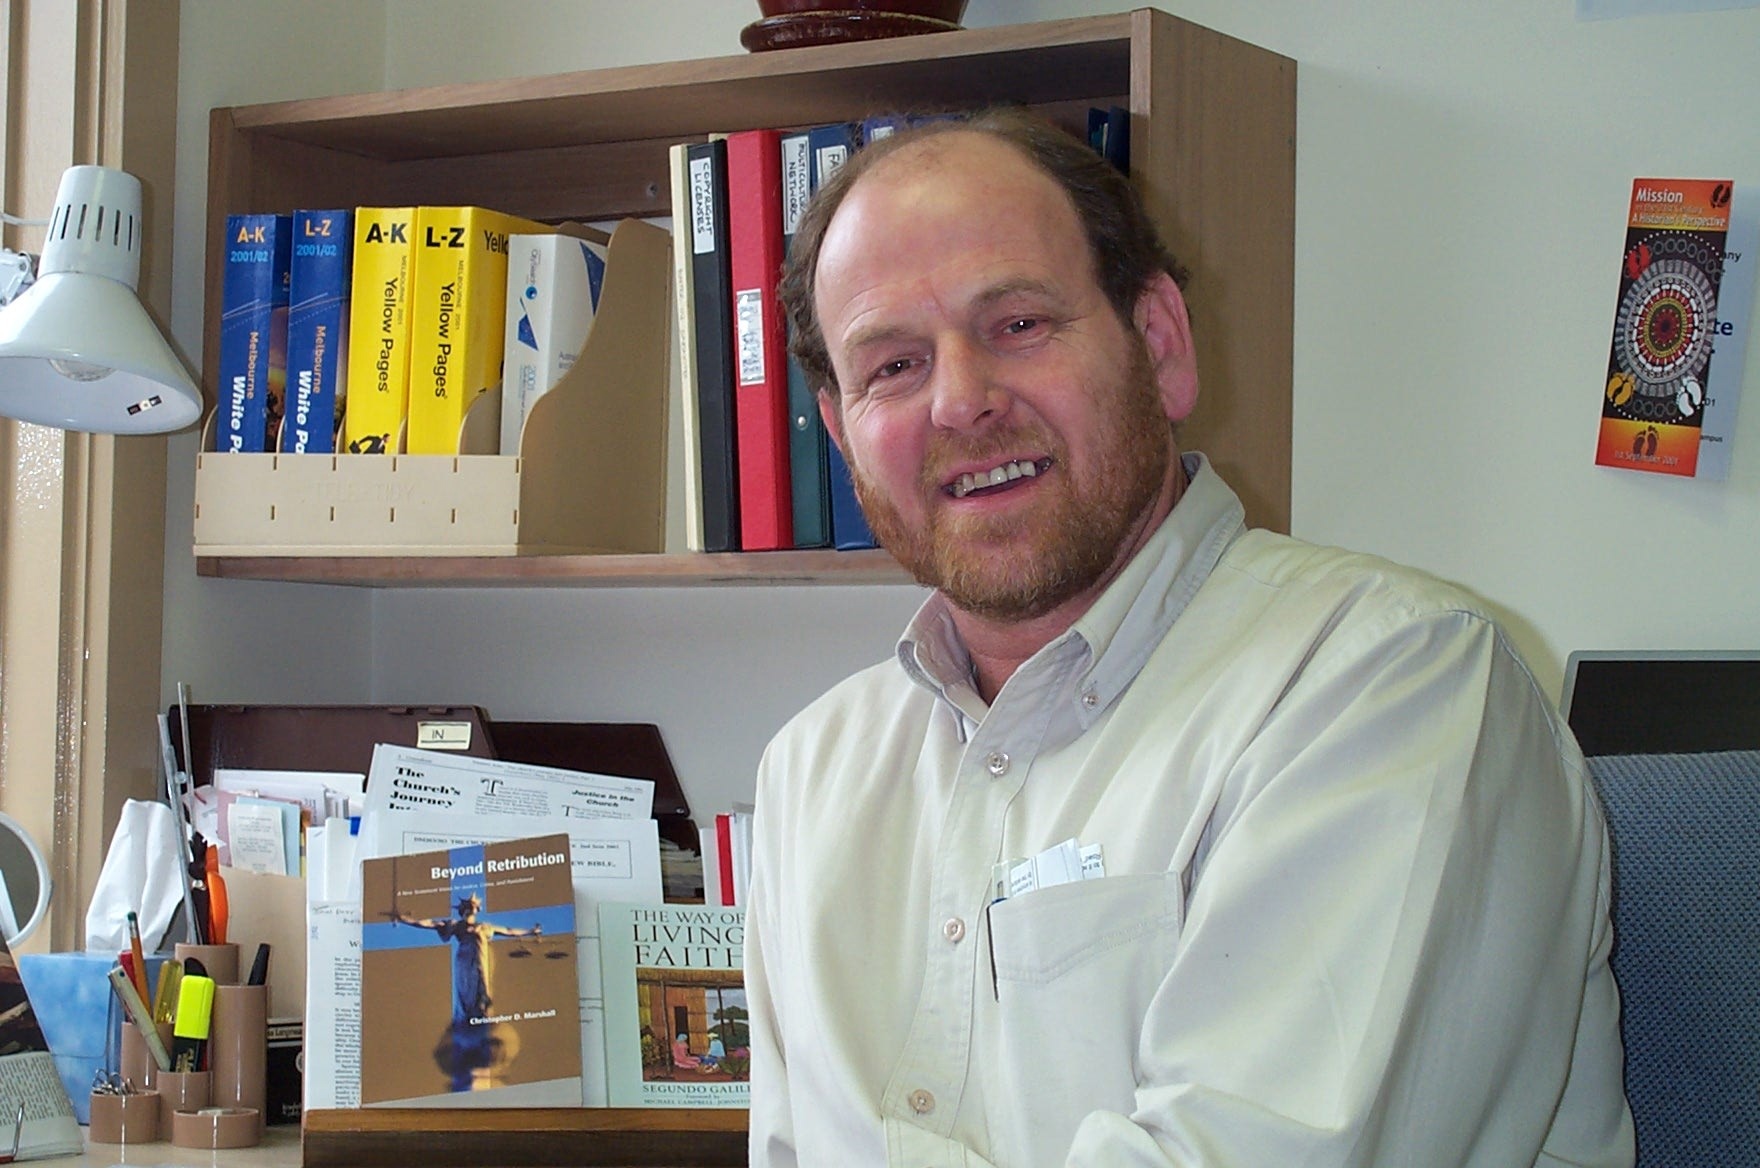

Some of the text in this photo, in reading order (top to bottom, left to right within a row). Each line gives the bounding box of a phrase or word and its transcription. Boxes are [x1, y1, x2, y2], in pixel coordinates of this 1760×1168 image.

[703, 162, 713, 236] COPYRIGHT
[788, 161, 798, 222] NETWORK
[1636, 187, 1684, 203] Mission
[695, 172, 705, 235] LICENSES
[237, 226, 266, 243] A-K
[304, 219, 332, 237] L-Z
[365, 222, 408, 244] A-K
[425, 226, 466, 249] L-Z
[230, 250, 269, 263] 2001/02
[296, 244, 338, 257] 2001/02
[375, 277, 398, 392] Yellow Pages
[433, 281, 456, 398] Yellow Pages
[247, 331, 259, 400] Melbourne
[313, 325, 326, 393] Melbourne
[230, 376, 246, 431] White
[296, 371, 312, 426] White
[431, 729, 445, 740] IN
[395, 766, 425, 778] The
[393, 778, 461, 796] Church's
[571, 790, 607, 799] Justice
[390, 791, 455, 809] Journey
[586, 799, 619, 808] Church
[431, 852, 566, 880] Beyond Retribution
[631, 909, 745, 925] THE WAY OF
[632, 924, 745, 945] LIVING
[469, 1014, 513, 1025] Christopher
[523, 1009, 557, 1020] Marshall
[642, 1084, 707, 1094] SEGUNDO
